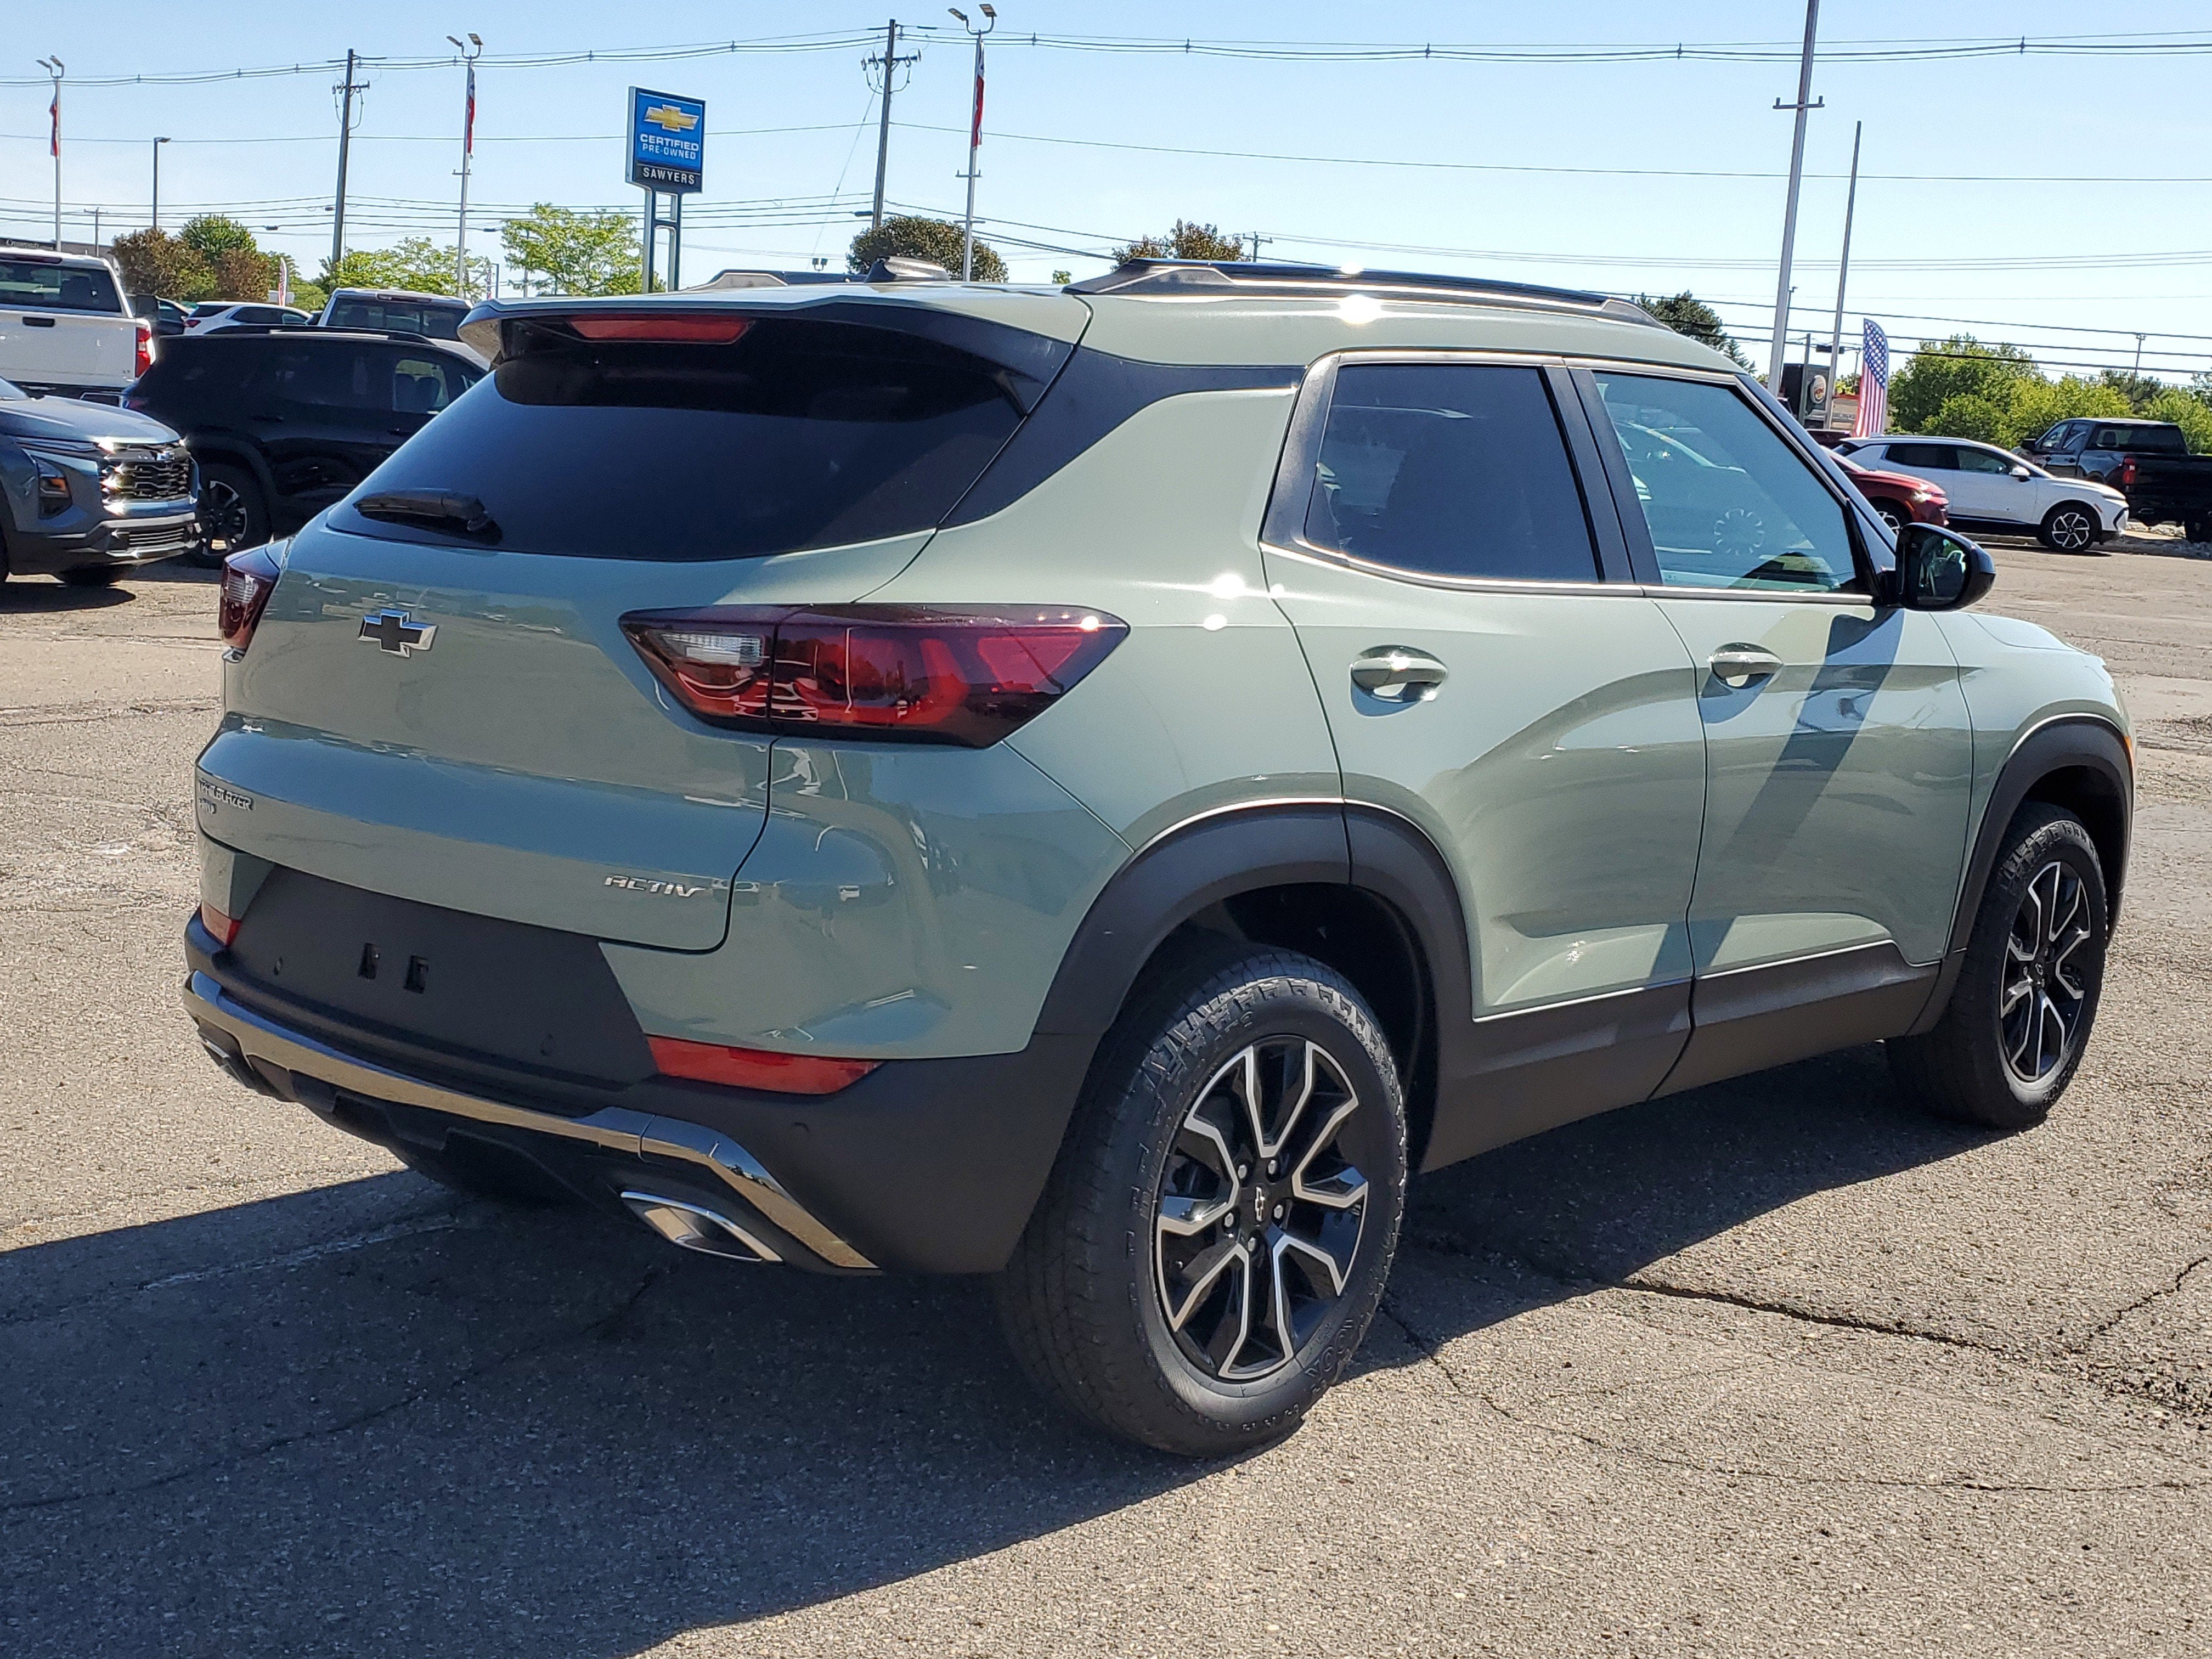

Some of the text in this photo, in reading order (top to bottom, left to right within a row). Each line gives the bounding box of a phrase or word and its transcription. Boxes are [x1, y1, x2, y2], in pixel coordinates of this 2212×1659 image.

[640, 133, 699, 151] CERTIFIED
[642, 143, 696, 160] PRE-OWNED
[642, 167, 695, 185] SAWYERS
[604, 874, 706, 898] ACTIV
